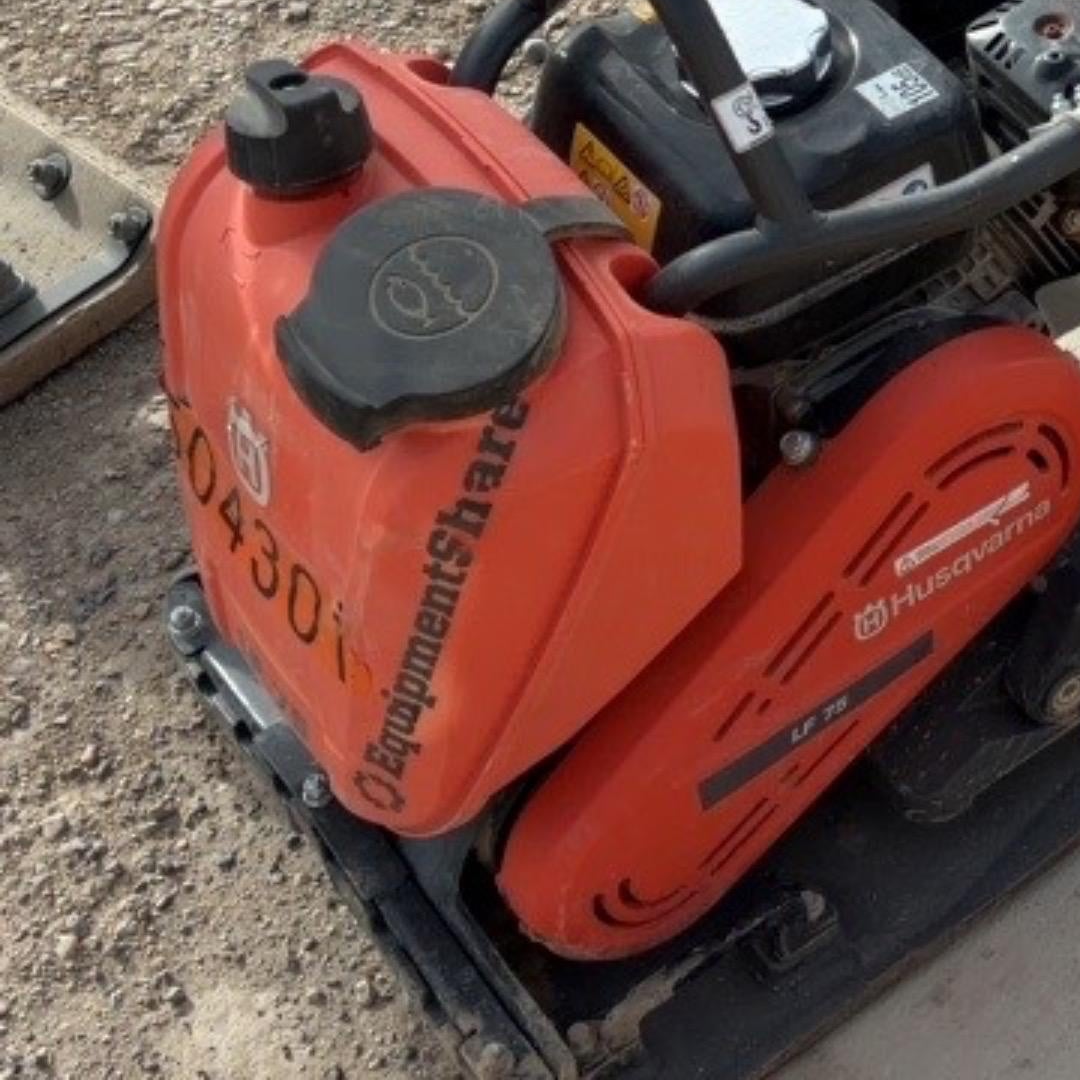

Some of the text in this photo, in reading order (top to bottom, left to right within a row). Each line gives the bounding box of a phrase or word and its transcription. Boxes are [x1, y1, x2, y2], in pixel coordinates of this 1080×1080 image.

[363, 397, 531, 783] EquipmentShare
[889, 499, 1051, 616] Husqvarna
[791, 716, 816, 745] LF
